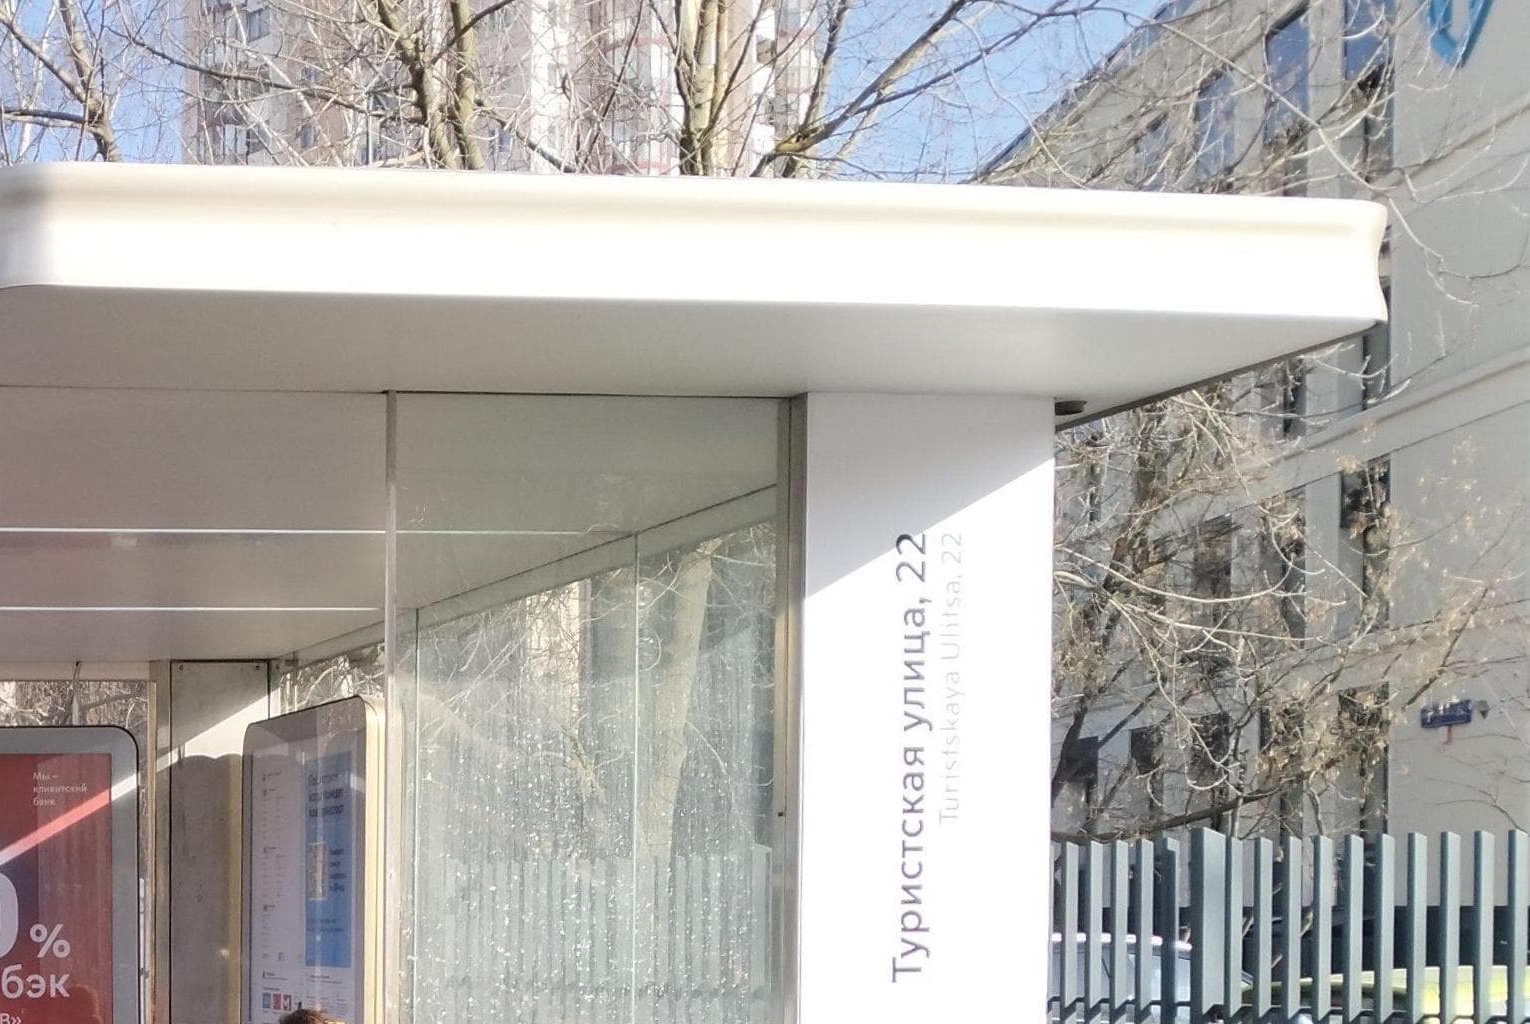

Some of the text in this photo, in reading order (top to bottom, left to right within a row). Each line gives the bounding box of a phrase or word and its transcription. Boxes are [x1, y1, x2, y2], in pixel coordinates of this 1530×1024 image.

[941, 533, 962, 563] 22
[891, 533, 933, 984] Туристская улица, 22
[938, 671, 965, 825] Turistskaya
